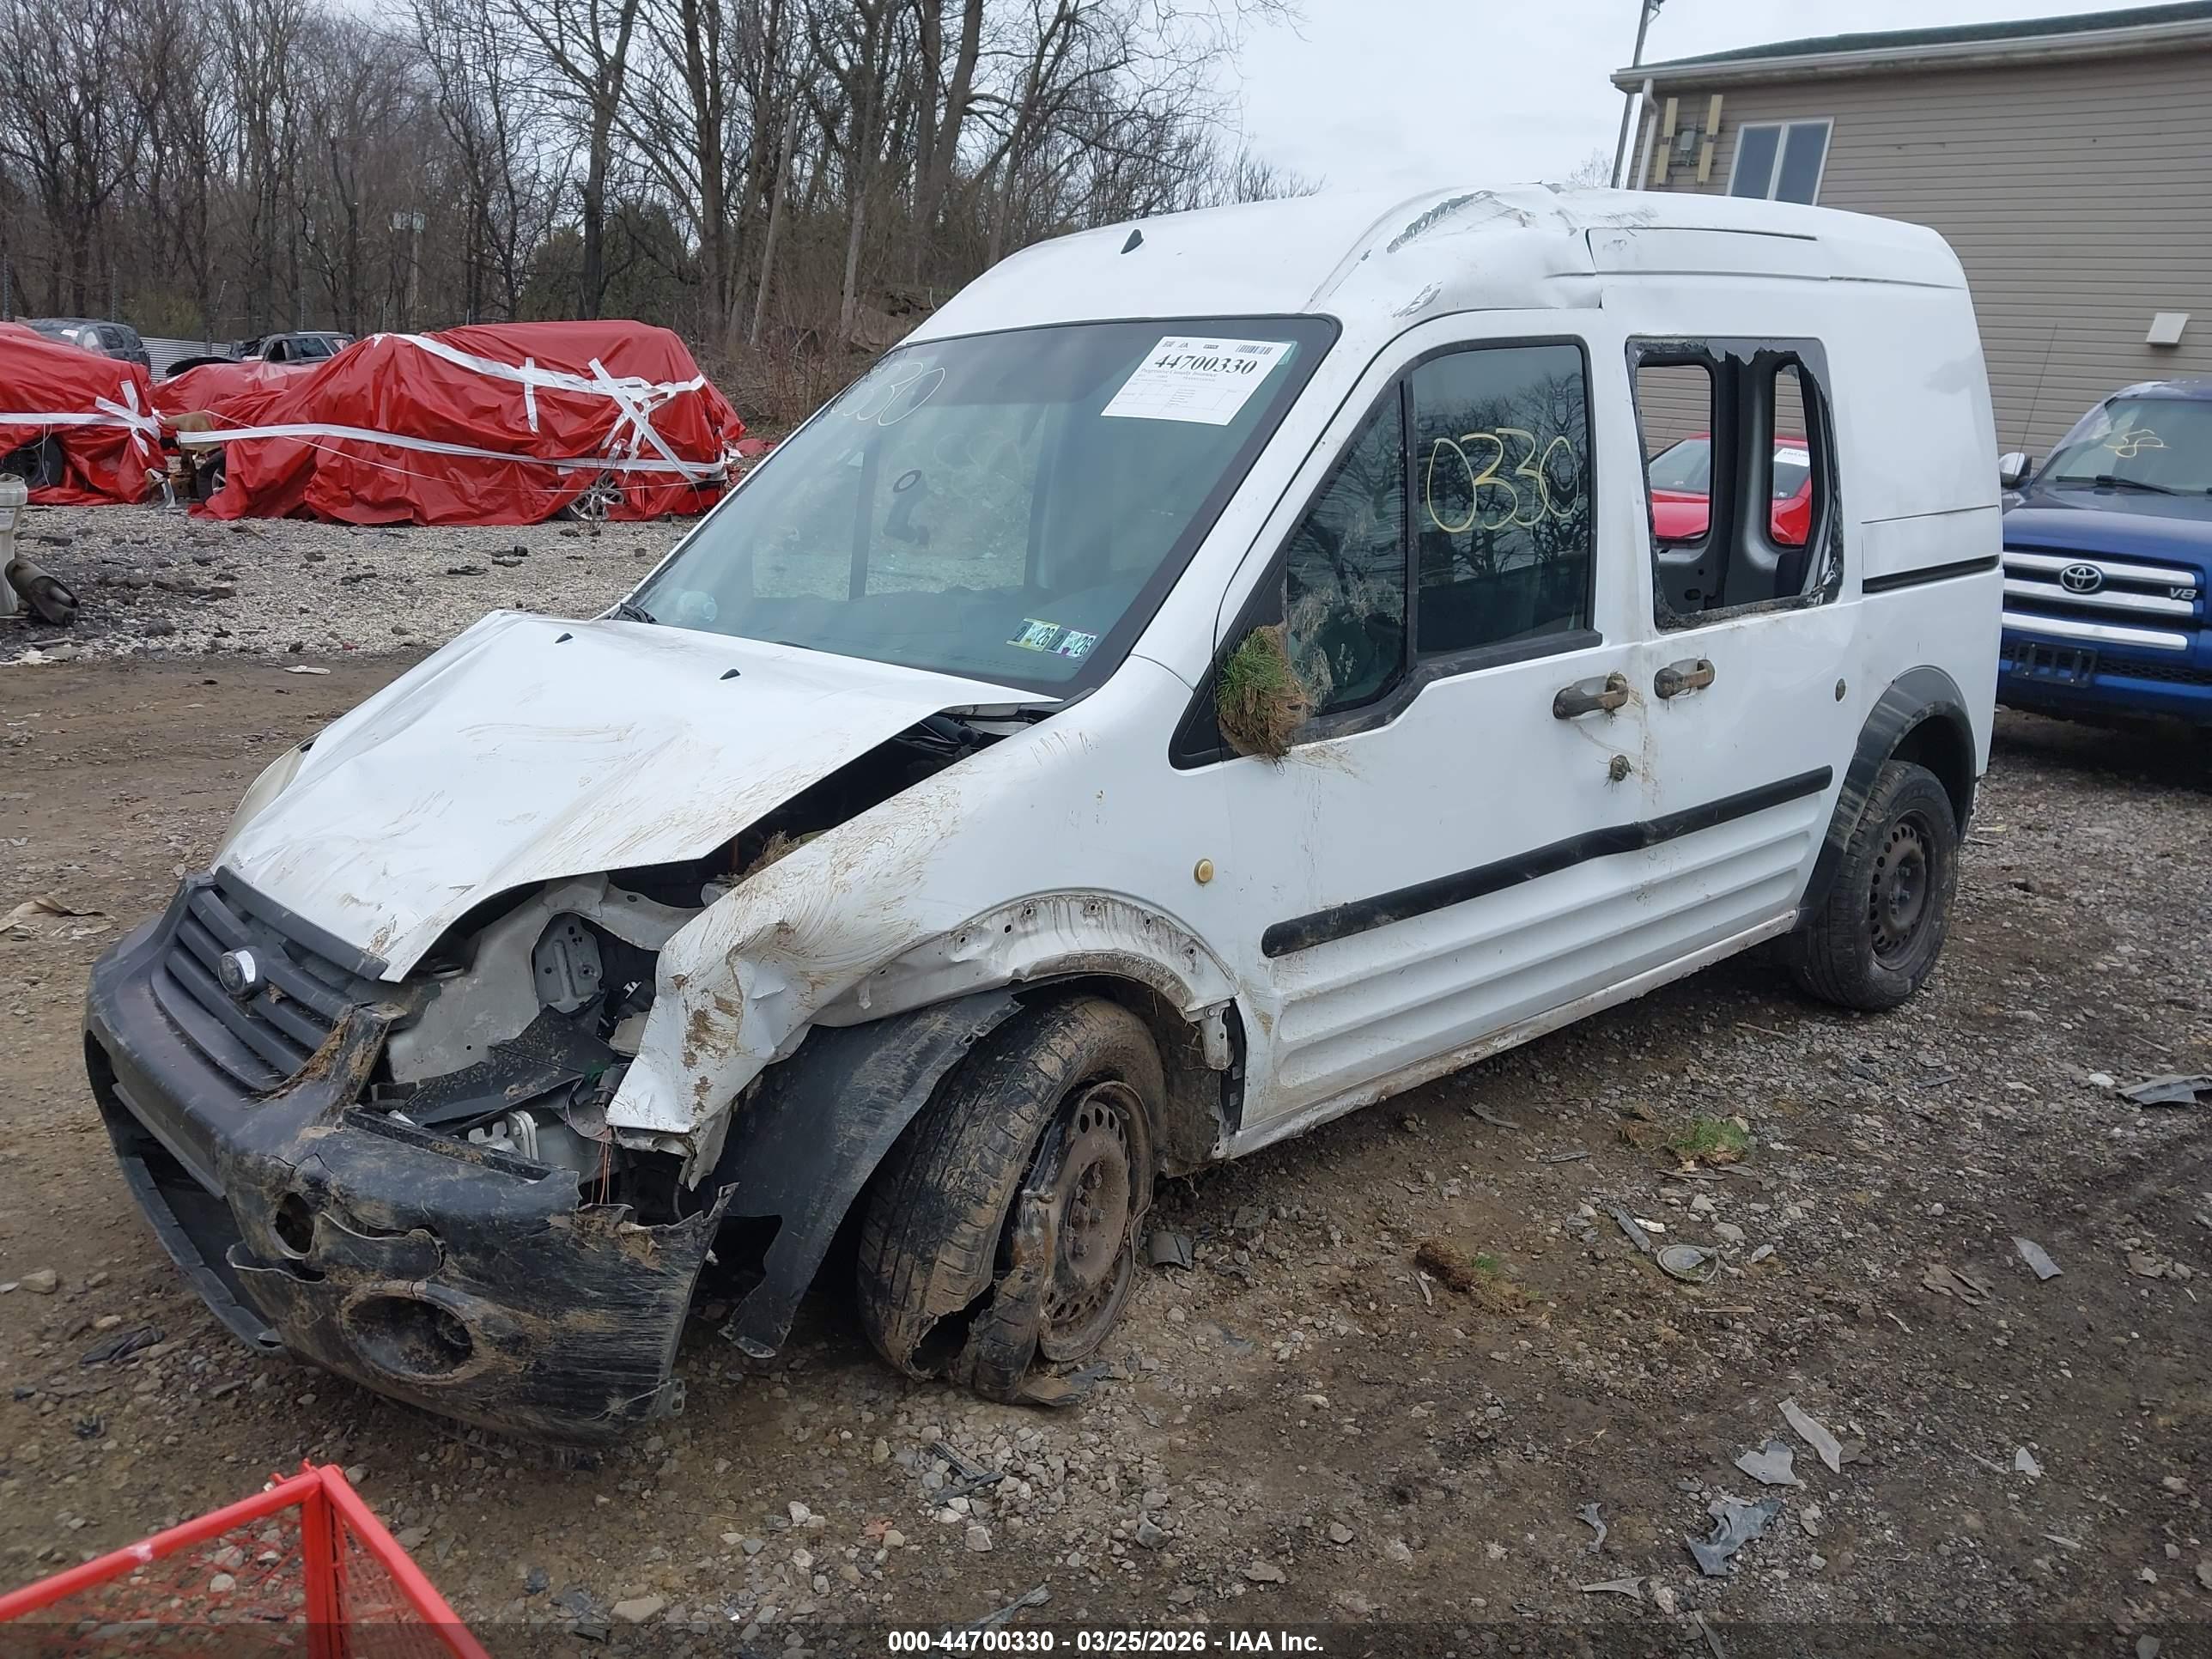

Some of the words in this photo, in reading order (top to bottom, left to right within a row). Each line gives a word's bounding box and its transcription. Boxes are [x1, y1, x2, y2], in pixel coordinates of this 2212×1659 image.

[1154, 354, 1258, 374] 44700330
[1427, 428, 1579, 533] 0330
[2170, 587, 2197, 599] V8
[1036, 627, 1055, 647] 26
[1073, 635, 1093, 655] 26
